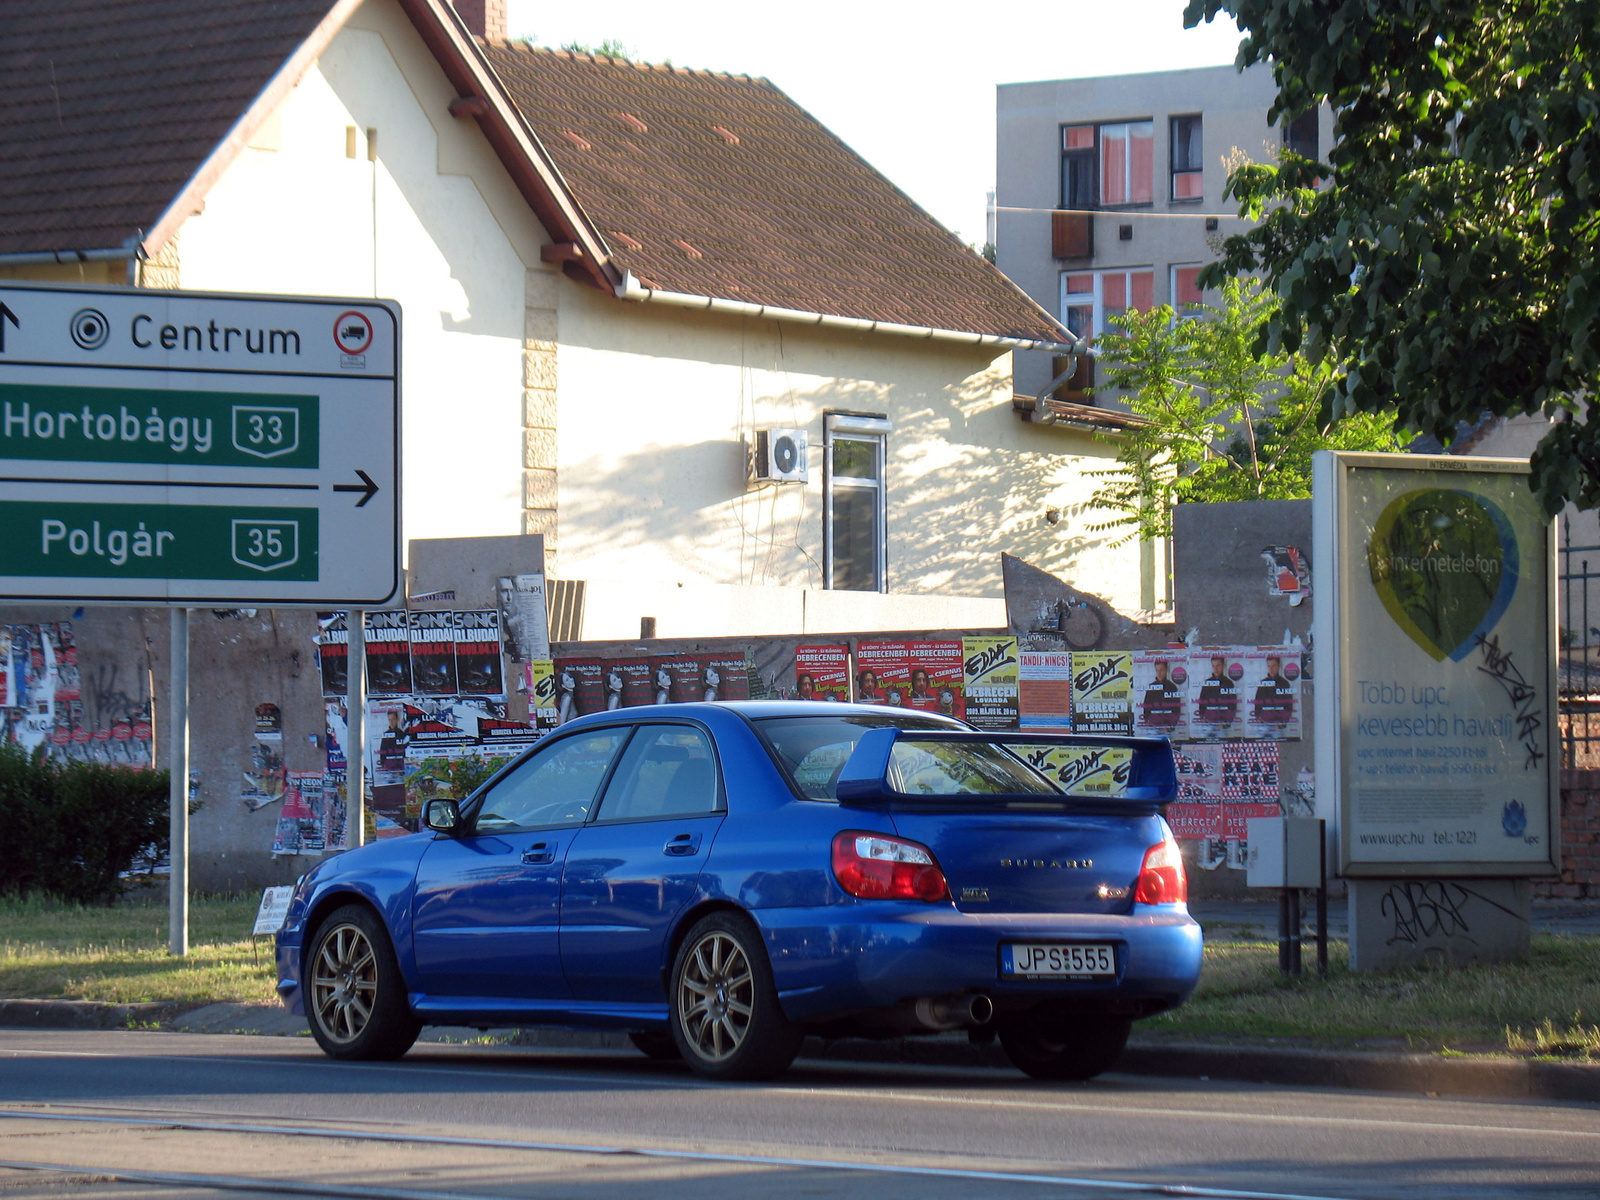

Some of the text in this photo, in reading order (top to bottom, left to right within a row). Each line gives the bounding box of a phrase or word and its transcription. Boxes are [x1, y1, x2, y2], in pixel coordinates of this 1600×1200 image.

[131, 314, 301, 355] Centrum
[4, 402, 283, 453] Hortobágy 33
[42, 519, 283, 566] Polgár 35
[365, 612, 407, 628] SONIC
[410, 612, 453, 628] SONIC
[454, 612, 498, 628] SONIC
[858, 650, 909, 658] DEBRECENBEN
[910, 649, 962, 657] DEBRECENBEN
[965, 641, 1015, 676] EDDA
[1045, 655, 1068, 667] NINCS!
[820, 671, 846, 682] CSERNUS
[883, 667, 909, 678] CSERNUS
[934, 666, 962, 677] CSERNUS
[1074, 656, 1126, 691] EDDA
[966, 687, 1017, 697] DEBRECEN
[1358, 680, 1450, 710] Több upc,
[1075, 702, 1128, 713] DEBRECEN
[1357, 713, 1514, 742] kevesebb havidíj
[1058, 749, 1110, 783] EDDA
[1170, 818, 1217, 827] DEBRECEN
[1359, 831, 1425, 845] www.upc.hu
[1456, 831, 1477, 844] 1221
[1001, 859, 1094, 868] SUBARU
